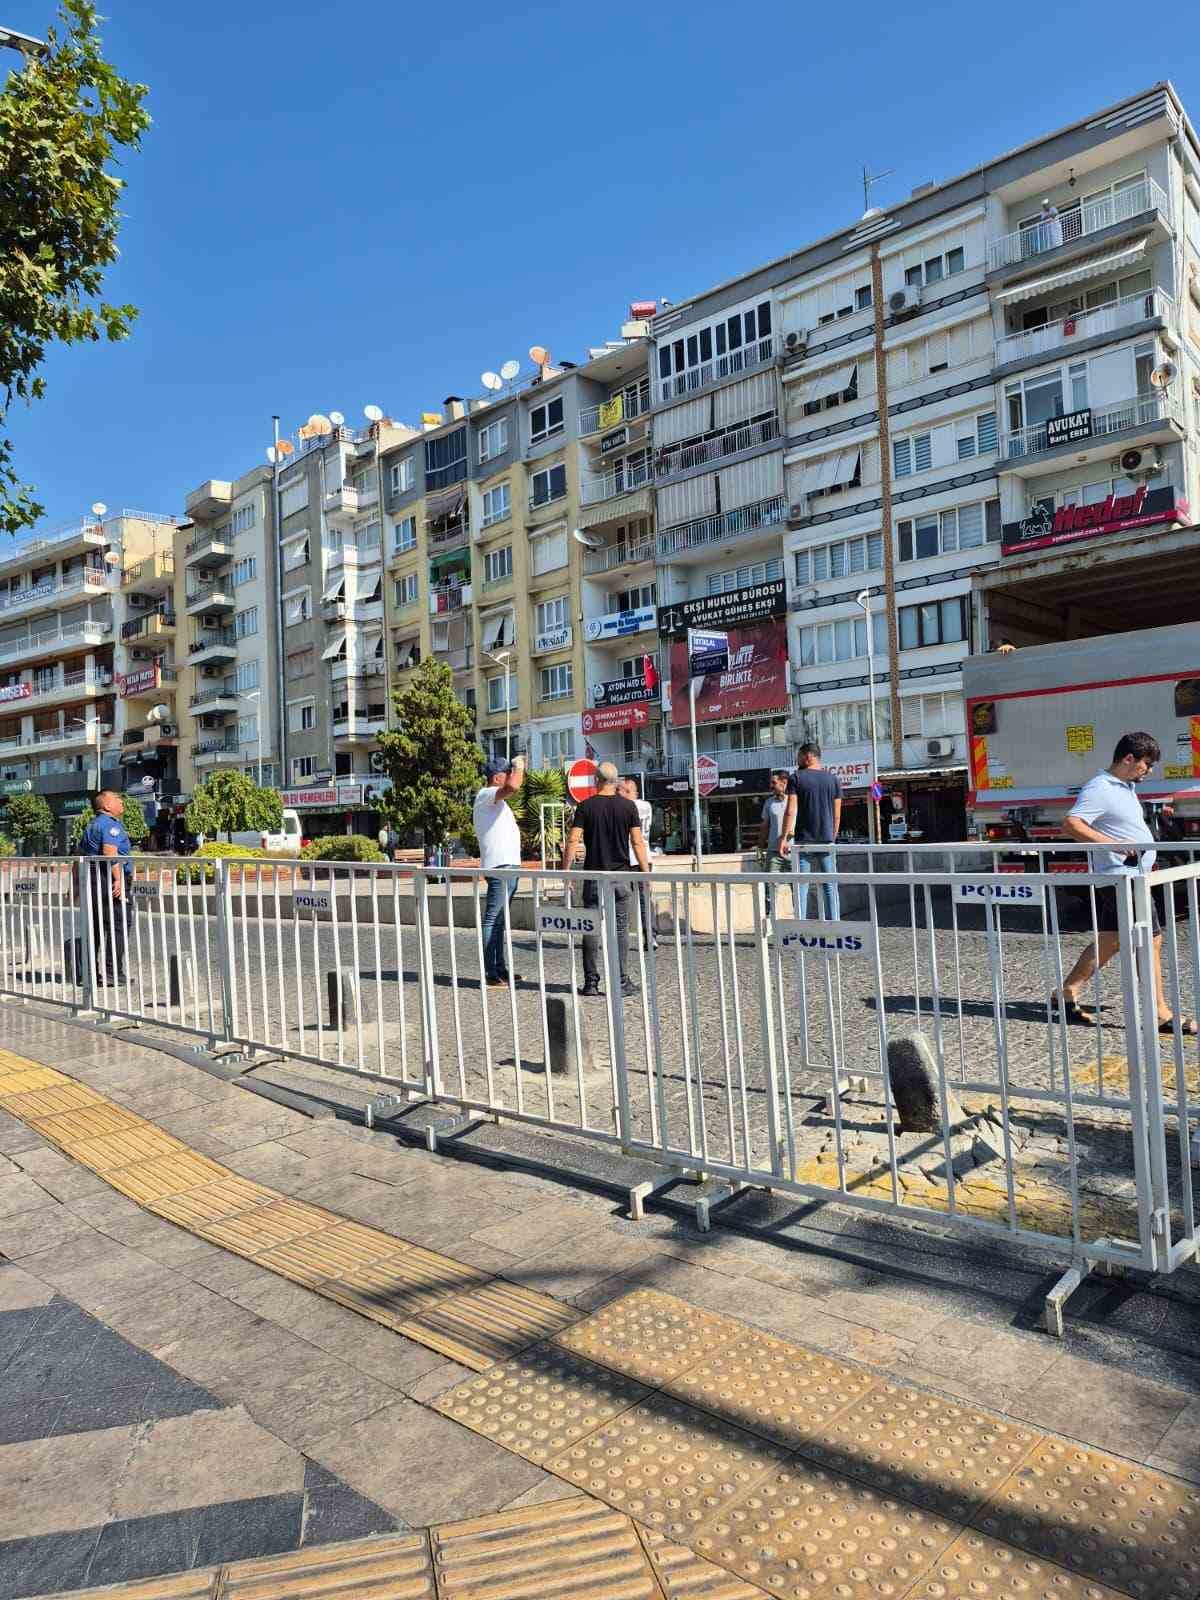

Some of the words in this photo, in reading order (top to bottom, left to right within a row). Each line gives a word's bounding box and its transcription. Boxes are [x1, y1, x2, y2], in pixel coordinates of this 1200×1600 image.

[1048, 412, 1089, 434] AVUKAT
[683, 602, 705, 614] EKŞİ
[707, 594, 740, 608] HUKUK
[742, 583, 783, 601] BÜROSU
[692, 610, 723, 624] AVUKAT
[755, 598, 776, 609] EKŞİ
[720, 669, 753, 688] BİRLİKTE
